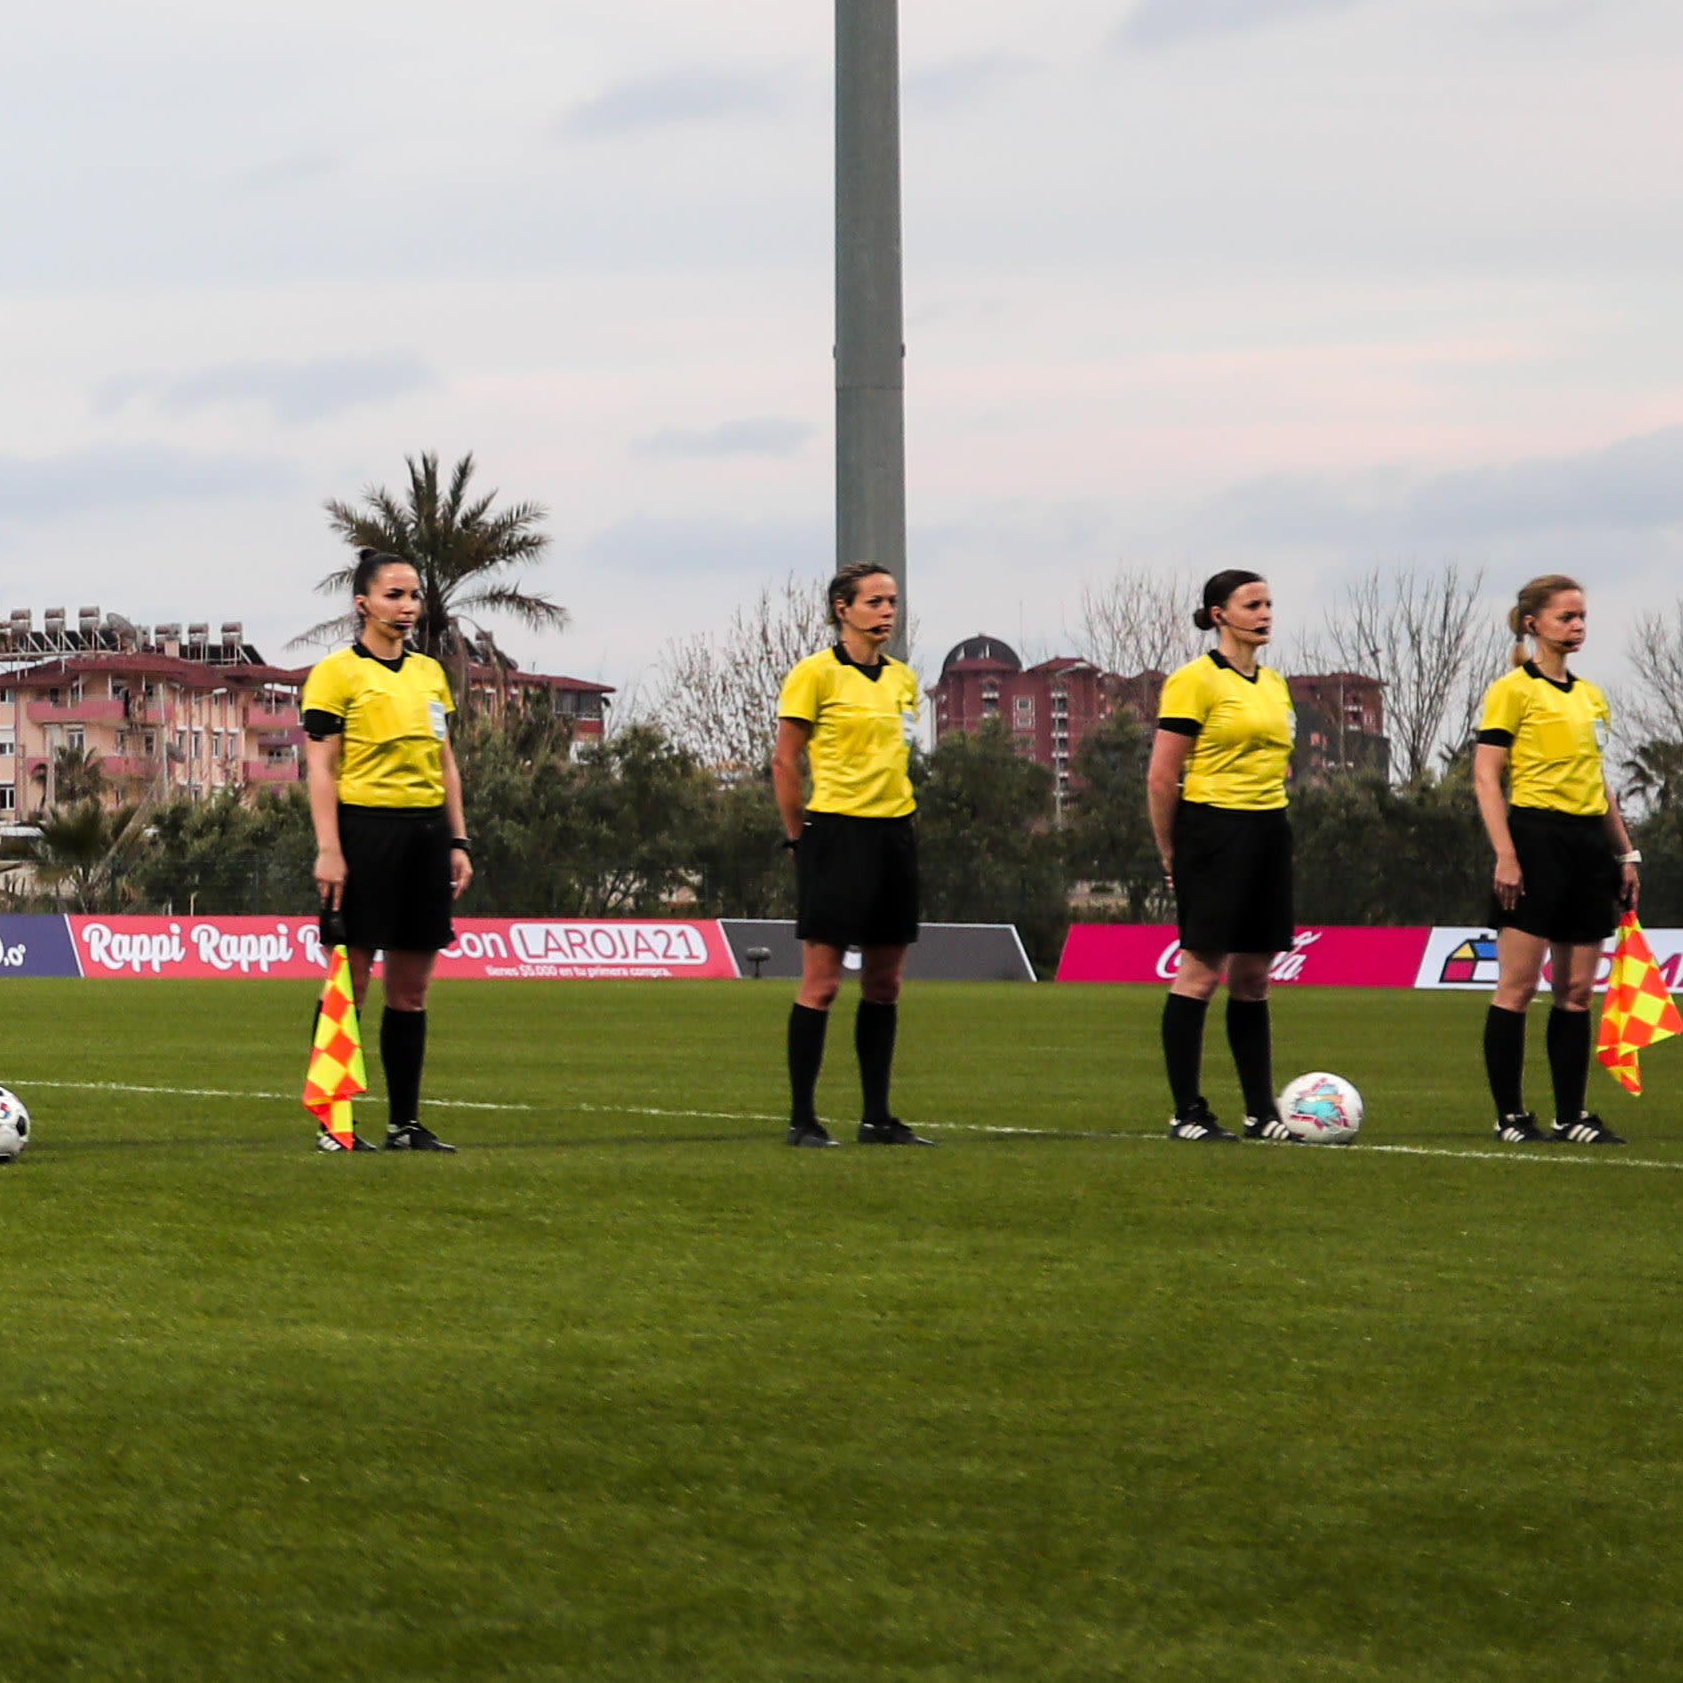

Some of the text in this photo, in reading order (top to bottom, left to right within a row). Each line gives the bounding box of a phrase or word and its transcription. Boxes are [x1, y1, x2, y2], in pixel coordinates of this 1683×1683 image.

[82, 923, 186, 973] Rappi
[191, 923, 293, 973] Rappi
[517, 928, 701, 960] LAROJA21
